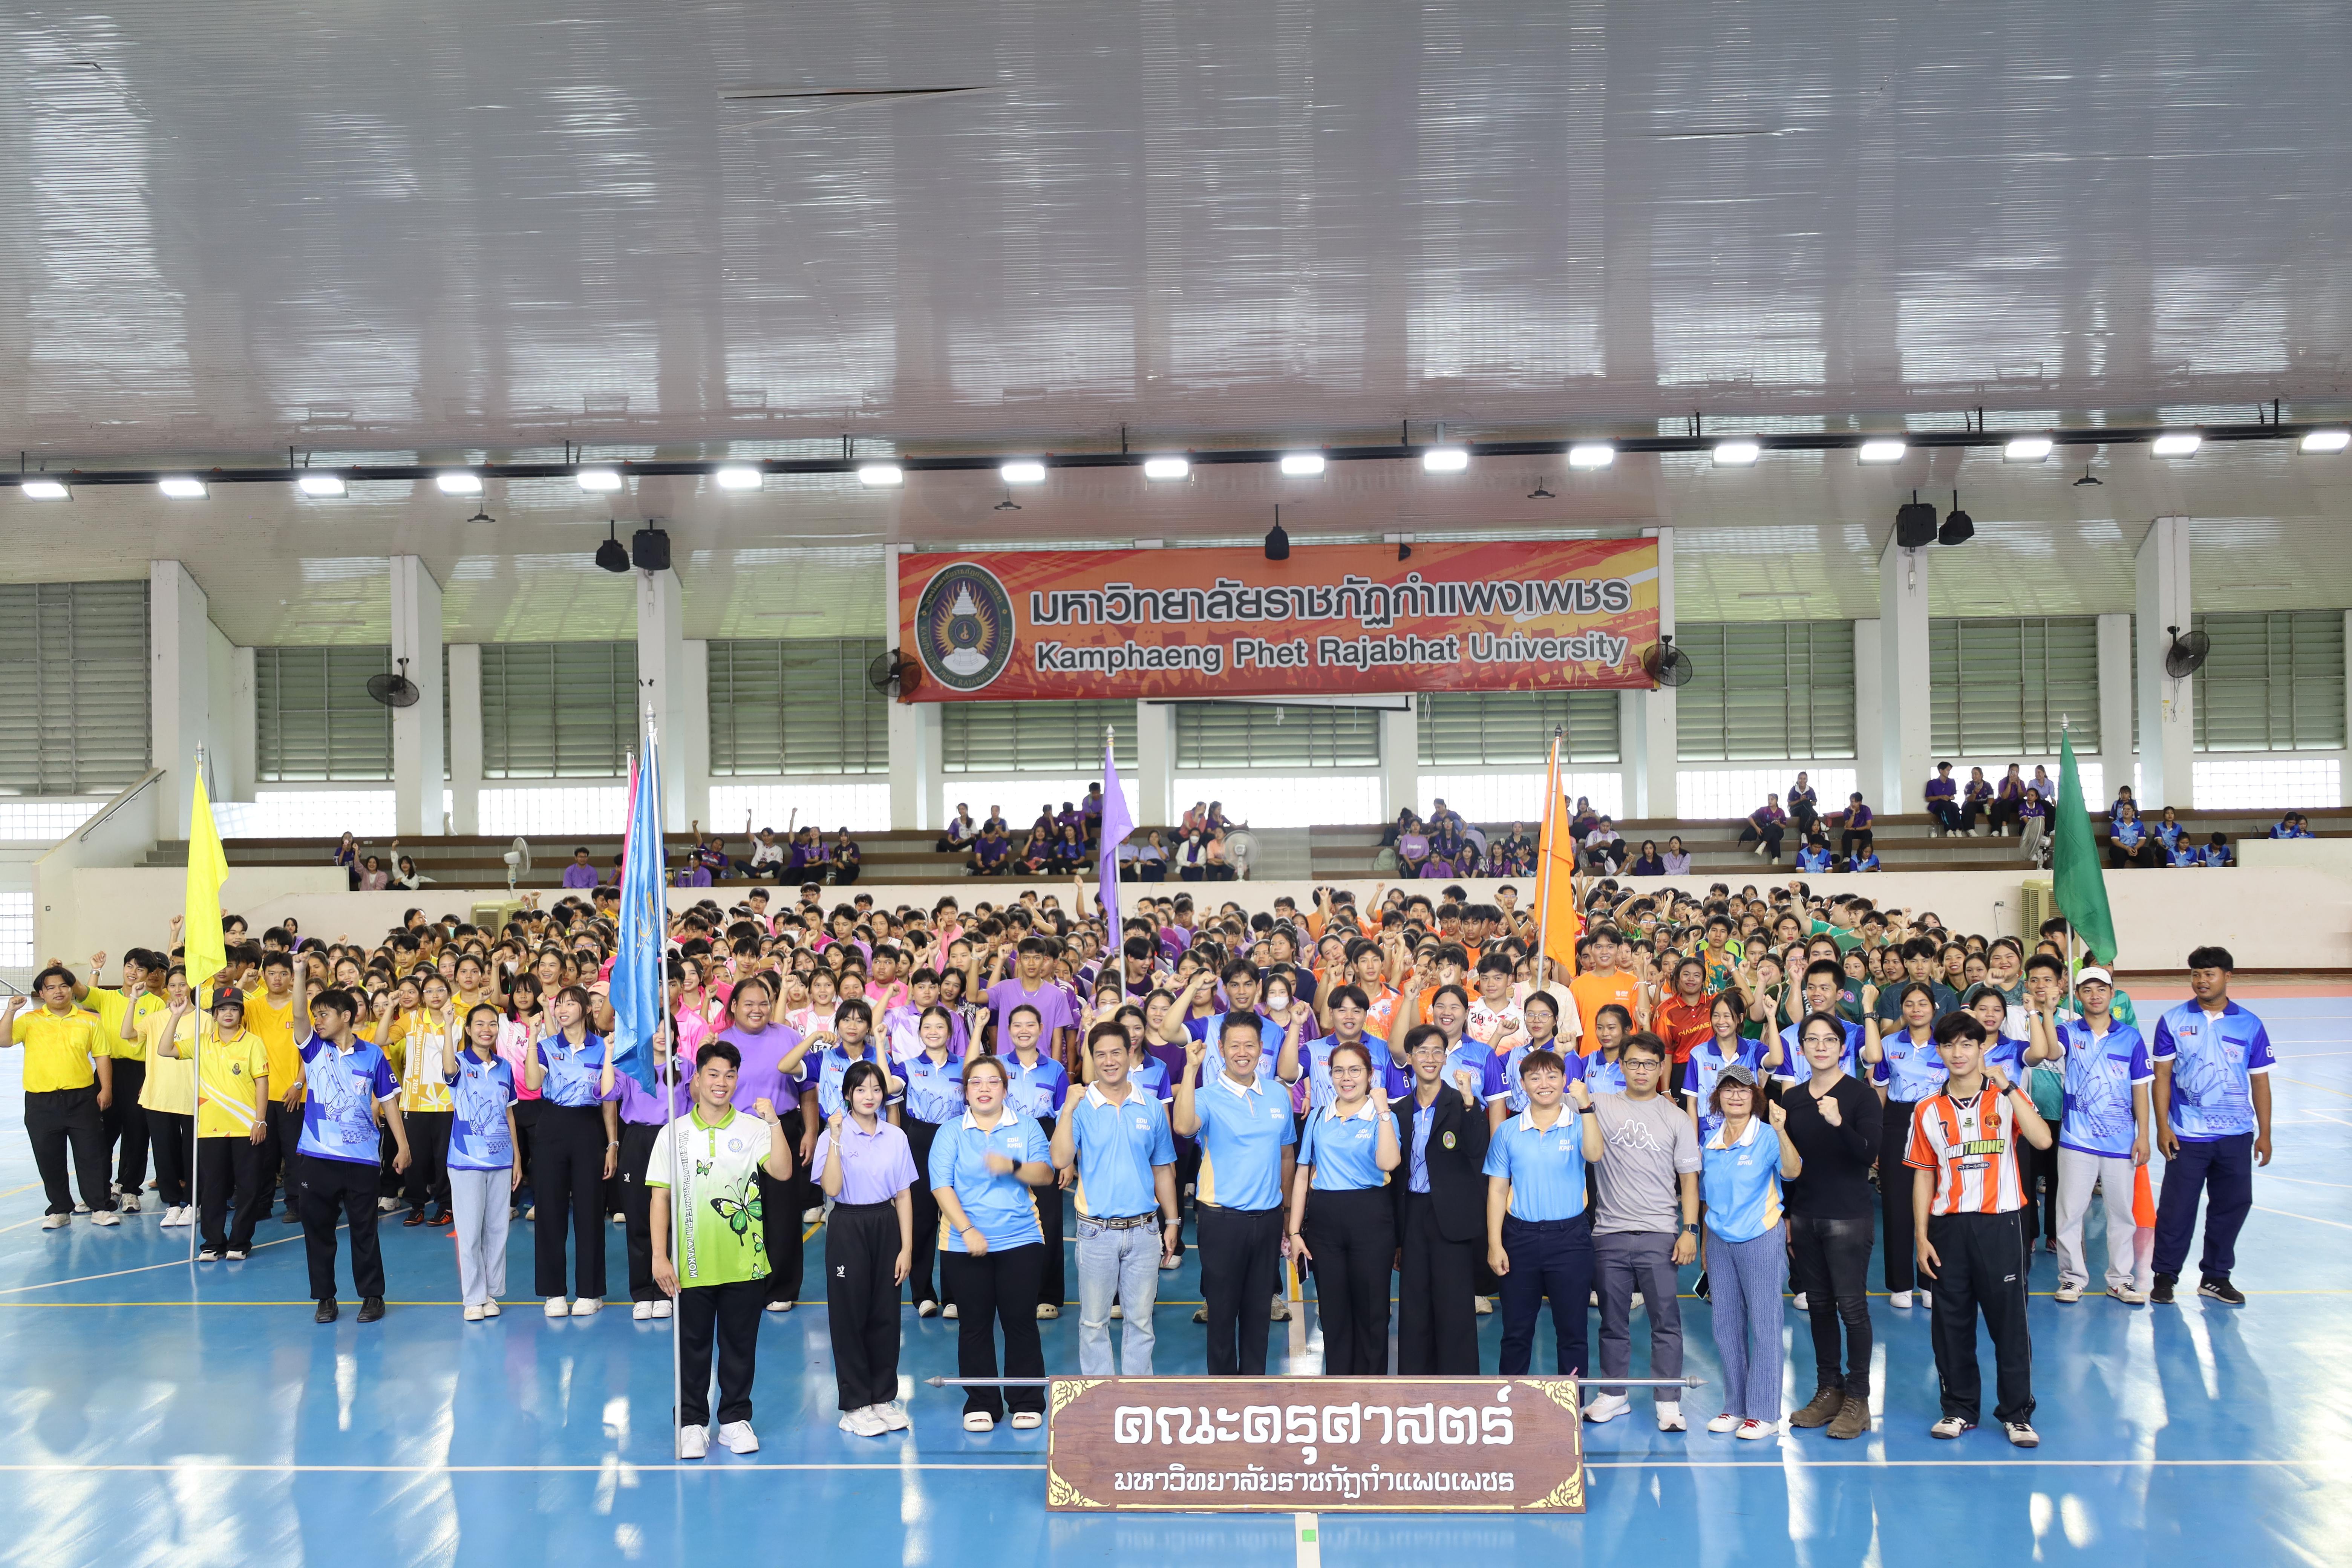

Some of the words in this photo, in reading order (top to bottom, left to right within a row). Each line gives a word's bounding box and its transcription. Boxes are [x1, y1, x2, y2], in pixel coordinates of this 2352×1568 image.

[1032, 573, 1629, 626] มหาวิทยาลัยราชภัฏกำแพงเพชร
[1037, 642, 1221, 674] Kamphaeng
[1236, 640, 1306, 666] Phet
[1319, 636, 1458, 670] Rajabhat
[1471, 633, 1626, 665] University
[1940, 1121, 1948, 1137] 7
[1114, 1384, 1514, 1465] คณะครุศาสตร์
[1114, 1463, 1514, 1499] มหาวิทยาลัยราชภัฏกำแพงเพชร
